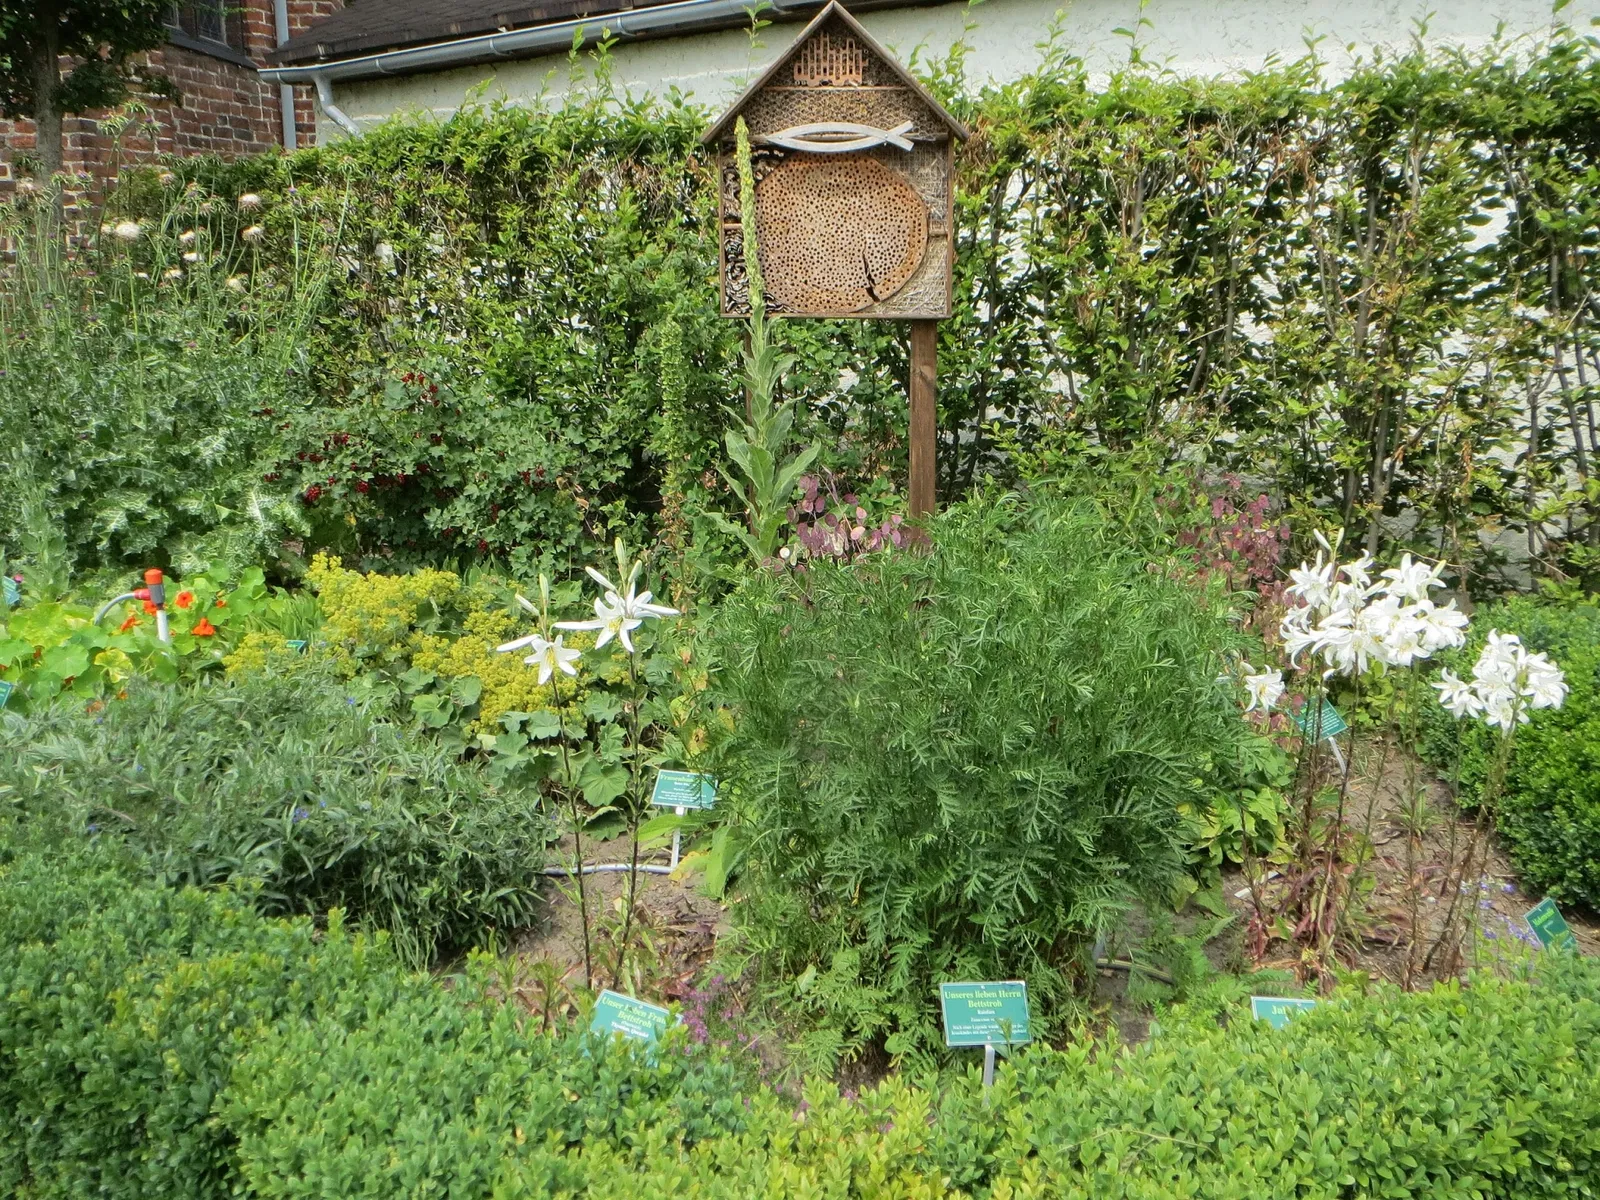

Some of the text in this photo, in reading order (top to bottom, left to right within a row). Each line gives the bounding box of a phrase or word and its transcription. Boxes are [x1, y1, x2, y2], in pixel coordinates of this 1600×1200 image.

[975, 990, 997, 999] lieben
[999, 990, 1021, 998] Herrn
[602, 997, 624, 1010] Unser
[968, 1000, 1003, 1008] Bettstroh
[617, 1010, 653, 1029] Bettstroh
